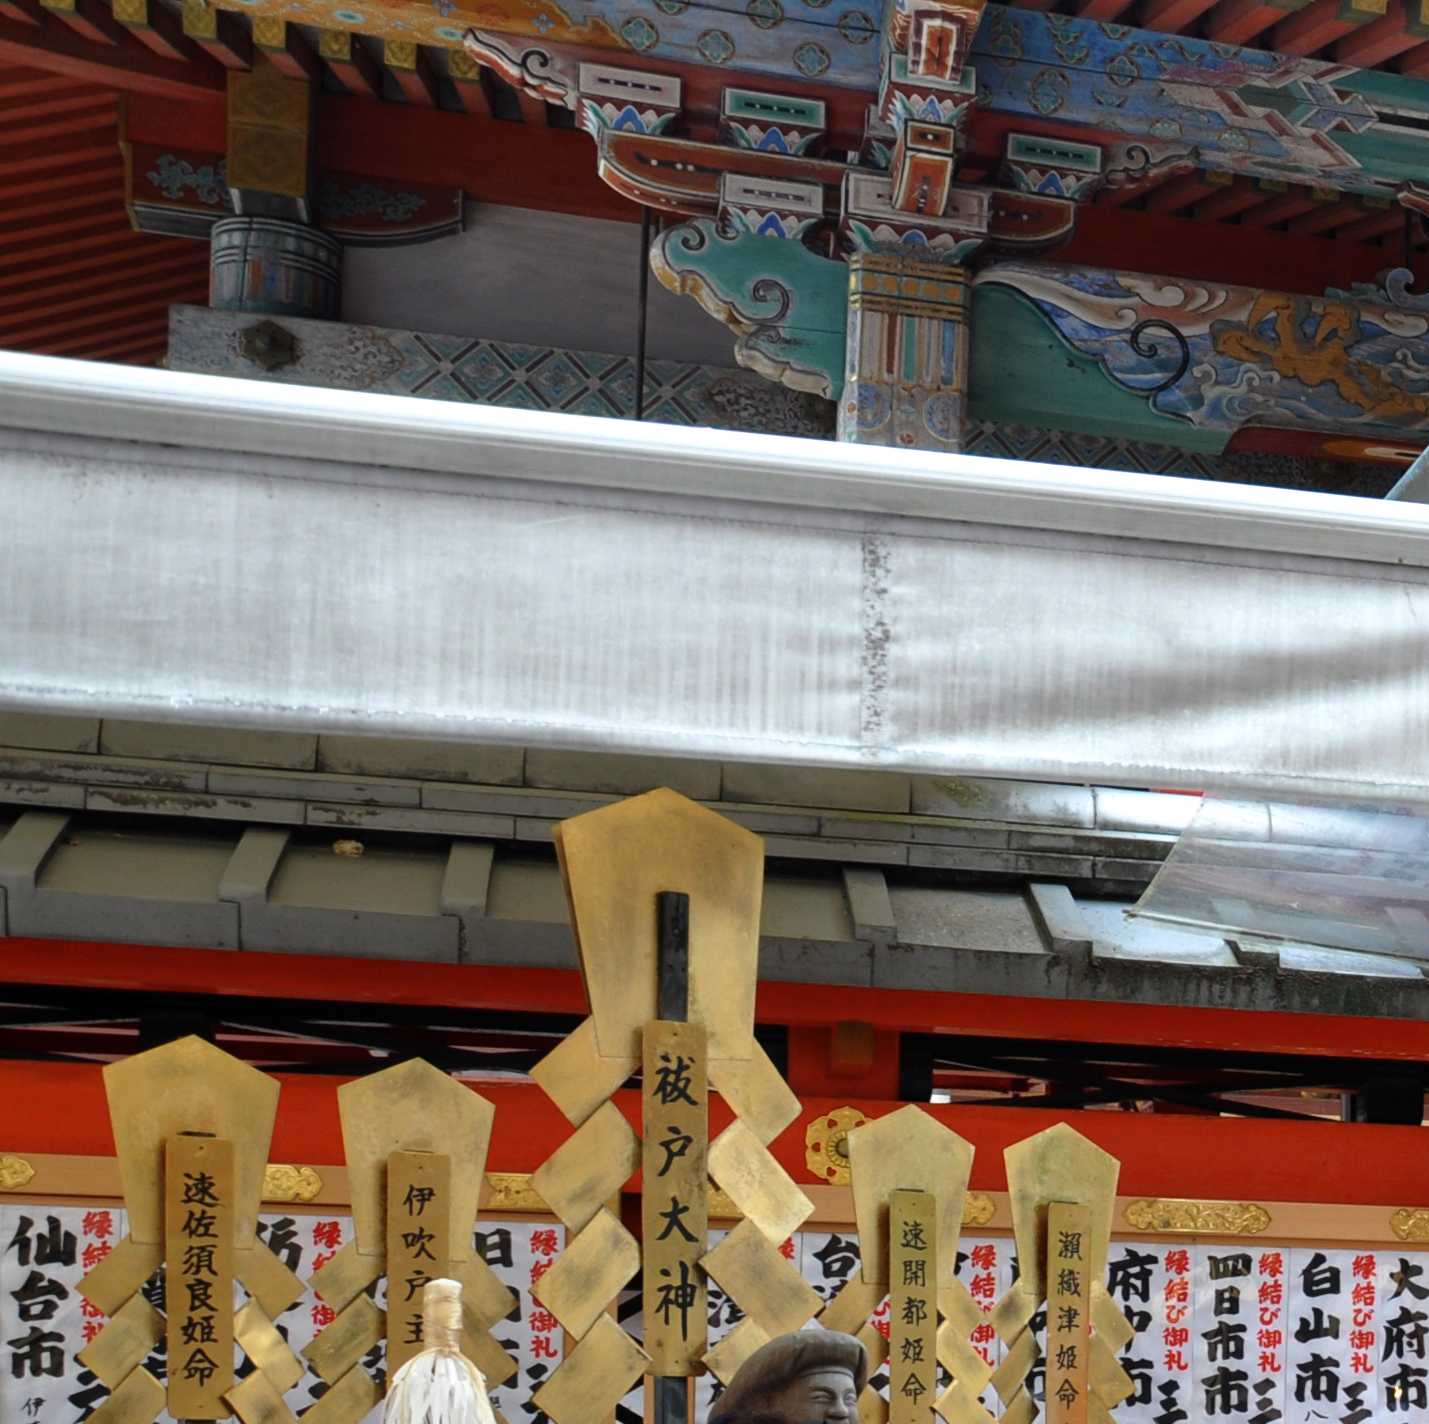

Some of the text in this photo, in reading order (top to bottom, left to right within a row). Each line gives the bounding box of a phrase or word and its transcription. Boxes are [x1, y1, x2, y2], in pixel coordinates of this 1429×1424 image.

[653, 1056, 699, 1342] 祓戸大神
[6, 1215, 78, 1379] 仙台市
[900, 1221, 928, 1405] 速開都姫命
[1163, 1250, 1191, 1371] 縁結び御礼
[1201, 1253, 1252, 1415] 四日市市
[1257, 1253, 1283, 1372] 縁結び御礼
[1295, 1253, 1341, 1402] 白山市
[1350, 1254, 1377, 1373] 縁結び御礼
